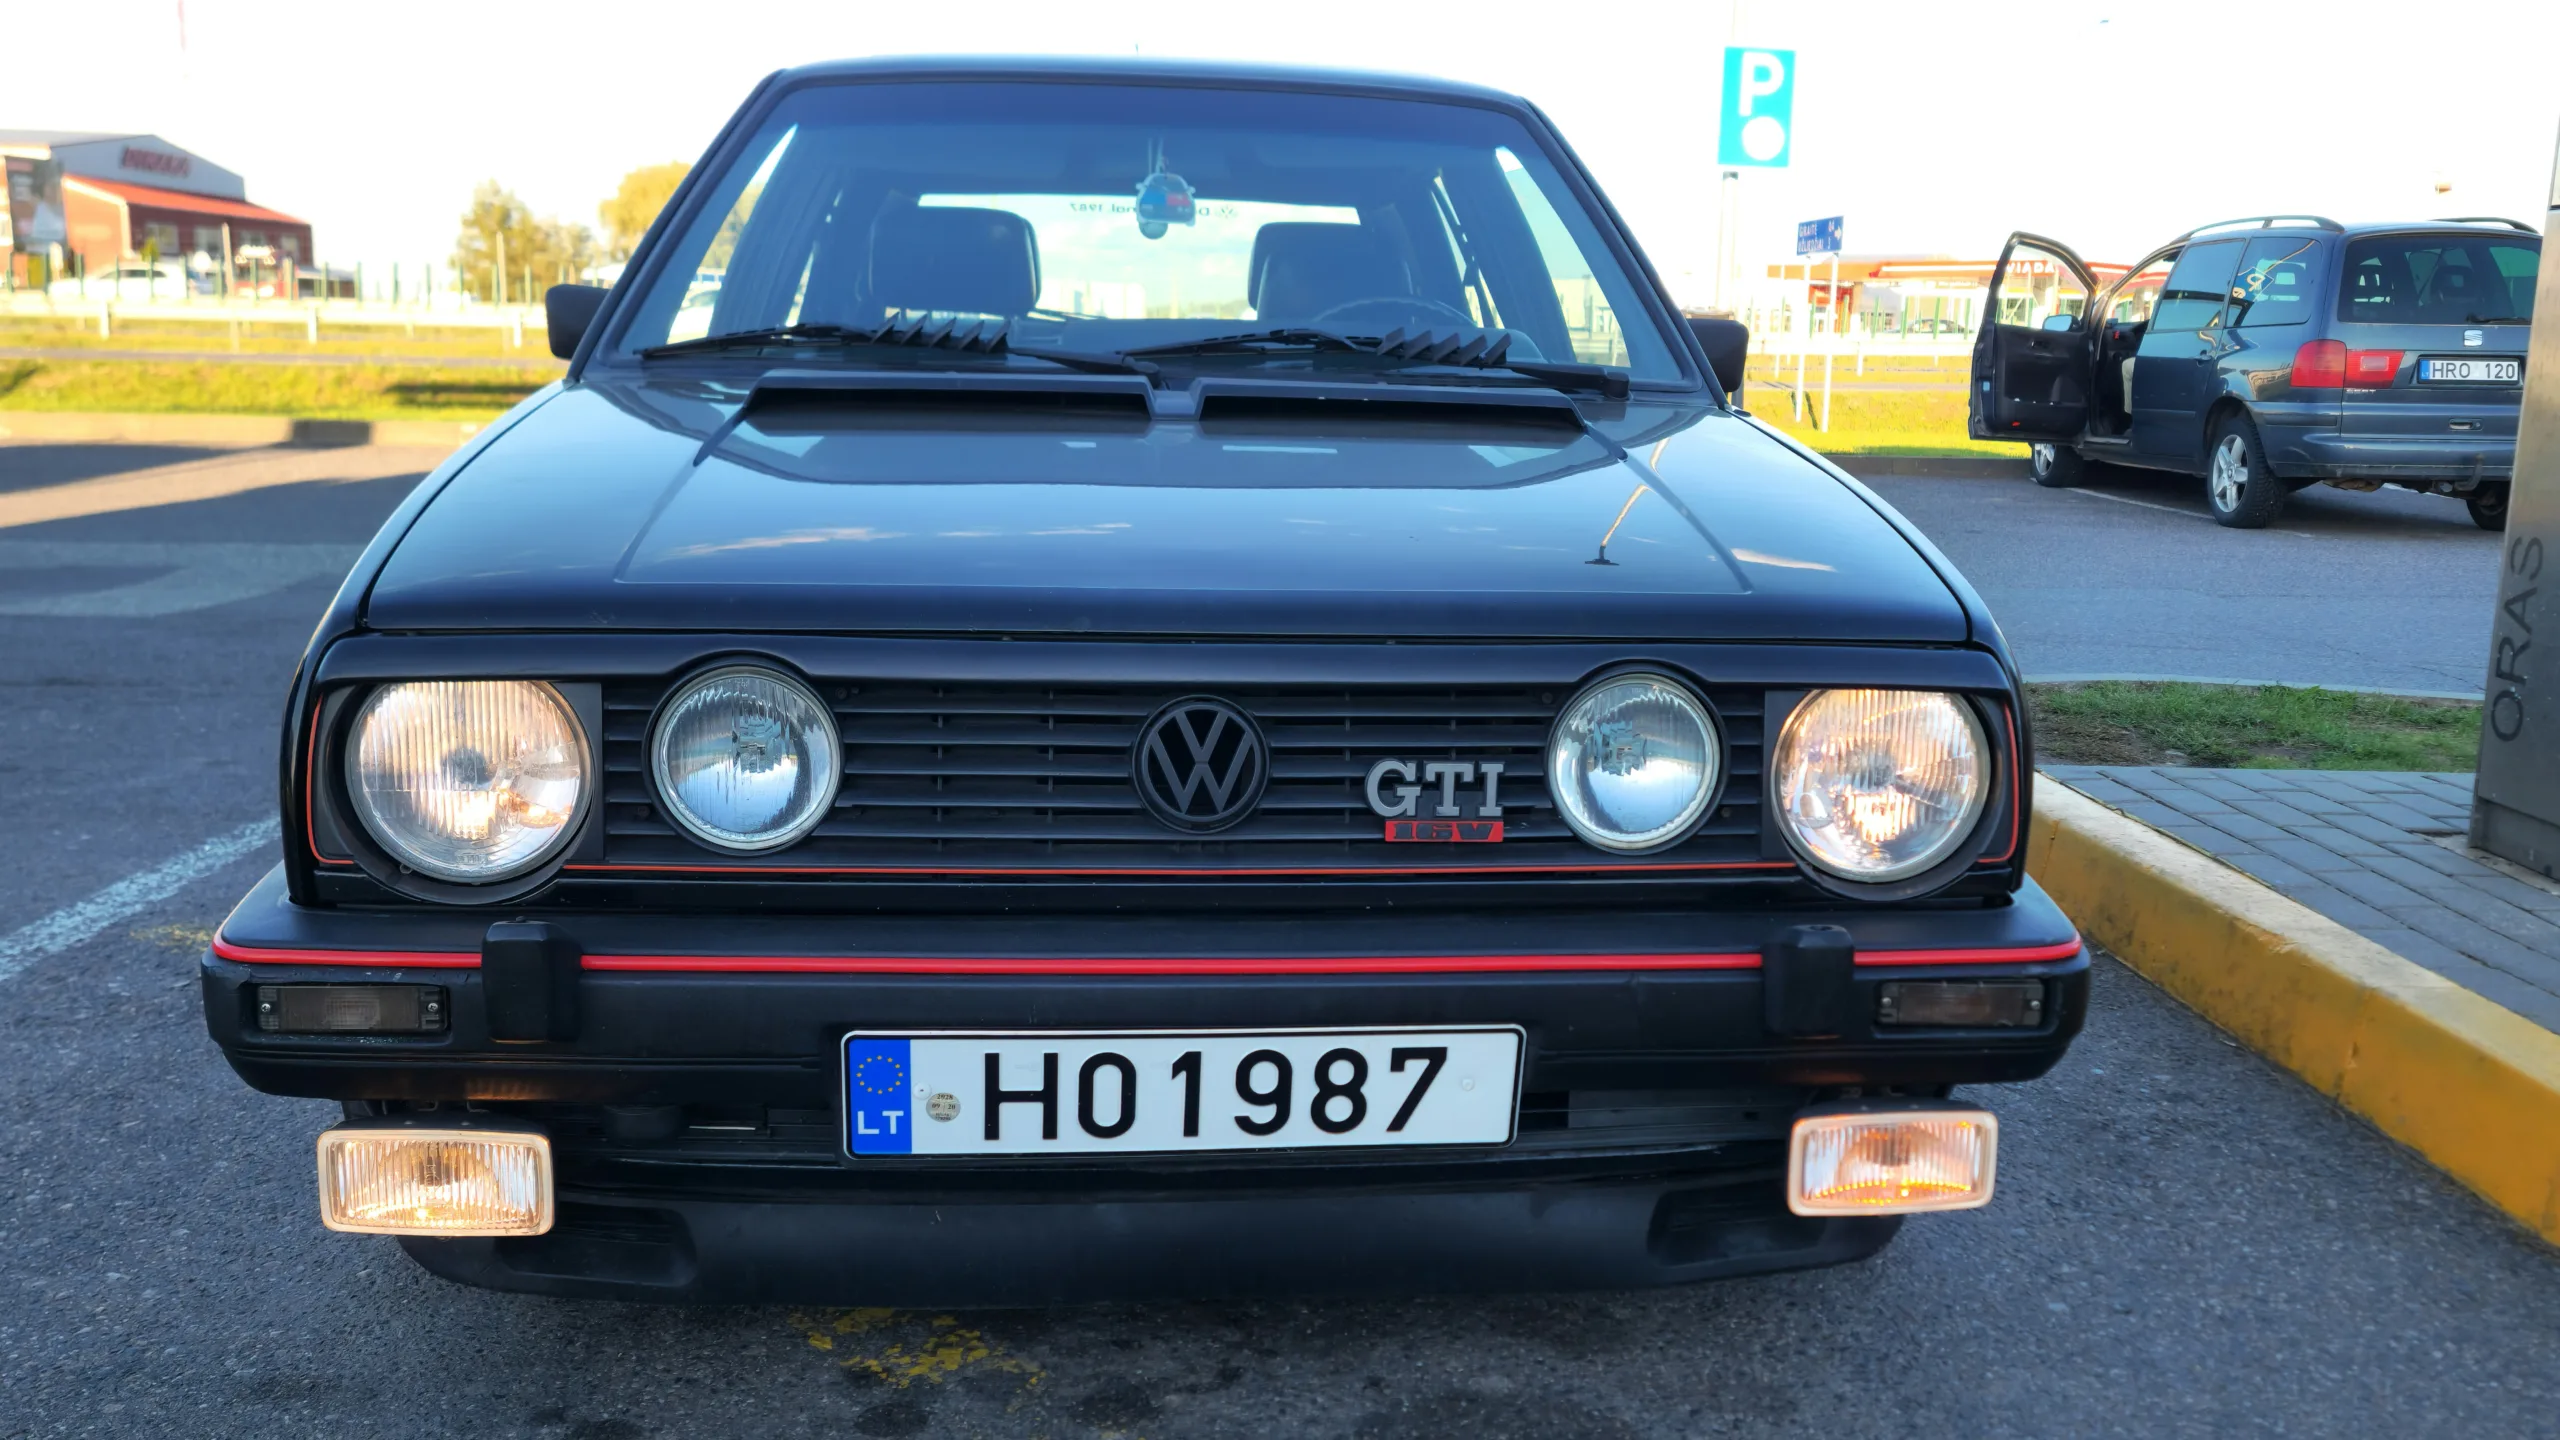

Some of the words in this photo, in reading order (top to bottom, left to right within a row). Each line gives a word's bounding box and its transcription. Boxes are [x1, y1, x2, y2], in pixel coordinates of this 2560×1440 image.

[1739, 51, 1785, 117] P
[2006, 259, 2056, 275] VIADA
[2432, 362, 2471, 379] HRO
[2484, 363, 2516, 379] 120
[2490, 536, 2544, 742] ORAS
[1365, 758, 1505, 817] GTI
[1394, 823, 1494, 840] 16V
[857, 1111, 904, 1134] LT
